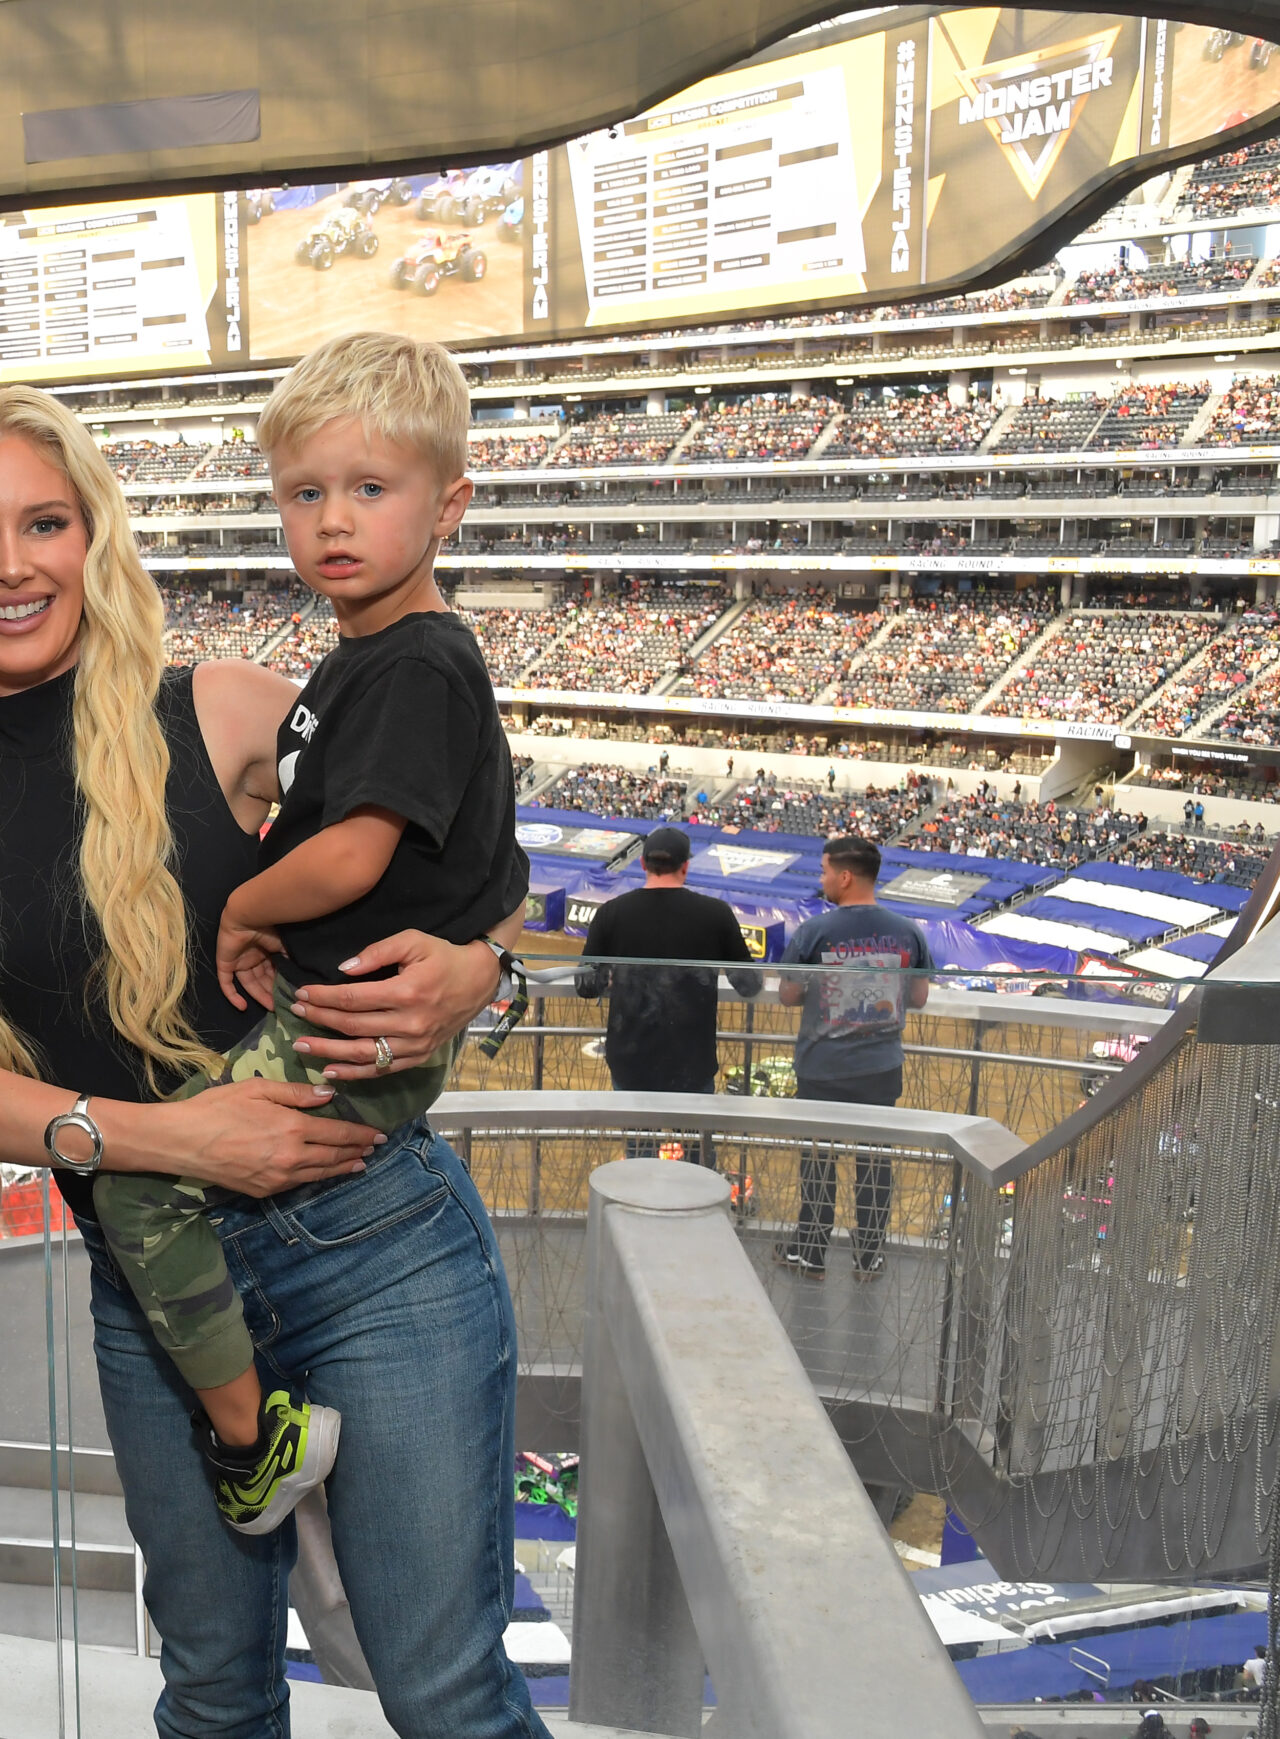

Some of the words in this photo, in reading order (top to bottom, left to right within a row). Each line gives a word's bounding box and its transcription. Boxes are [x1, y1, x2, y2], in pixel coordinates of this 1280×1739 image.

[959, 57, 1113, 125] MONSTER
[1000, 100, 1072, 144] JAM
[890, 40, 916, 273] #MONSTERJAM
[1067, 726, 1114, 738] RACING
[1132, 984, 1169, 1003] CARS
